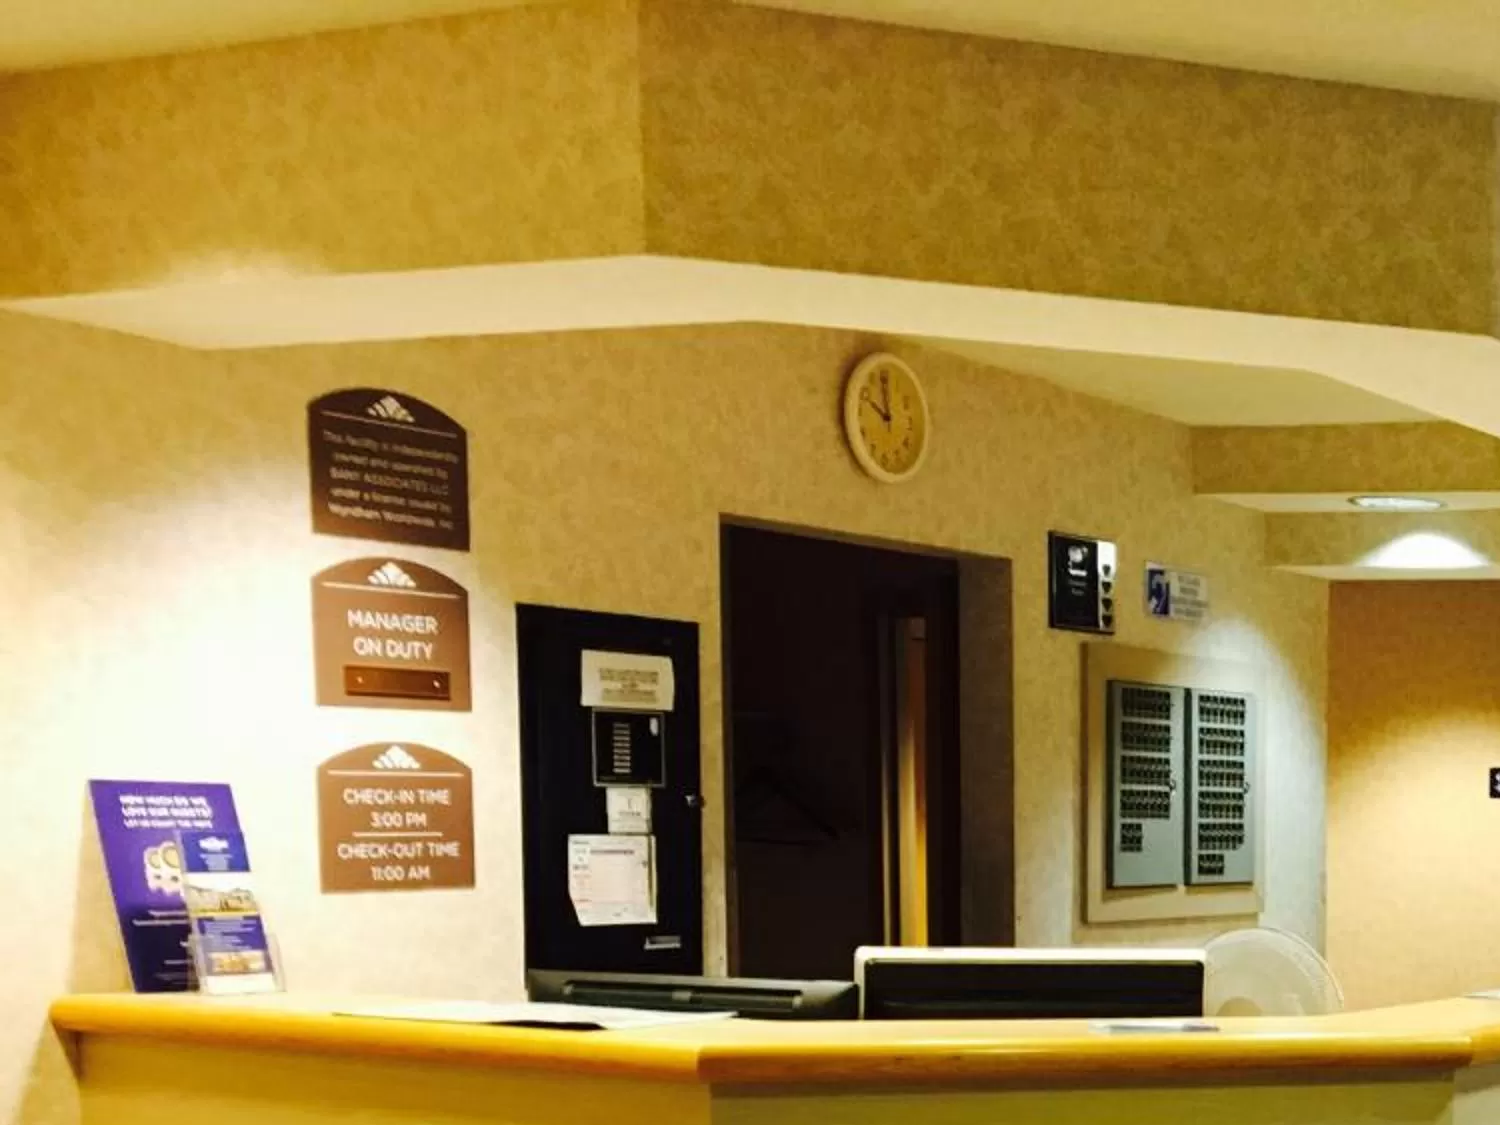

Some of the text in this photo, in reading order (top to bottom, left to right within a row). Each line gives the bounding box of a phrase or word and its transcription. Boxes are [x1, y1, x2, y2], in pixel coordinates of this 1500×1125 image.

[347, 608, 439, 636] MANAGER
[353, 636, 434, 660] ON DUTY
[343, 787, 451, 806] CHECK-IN TIME
[370, 811, 428, 828] 3:00 PM
[336, 841, 461, 860] CHECK-OUT TIME
[370, 865, 431, 881] 11:00 AM
